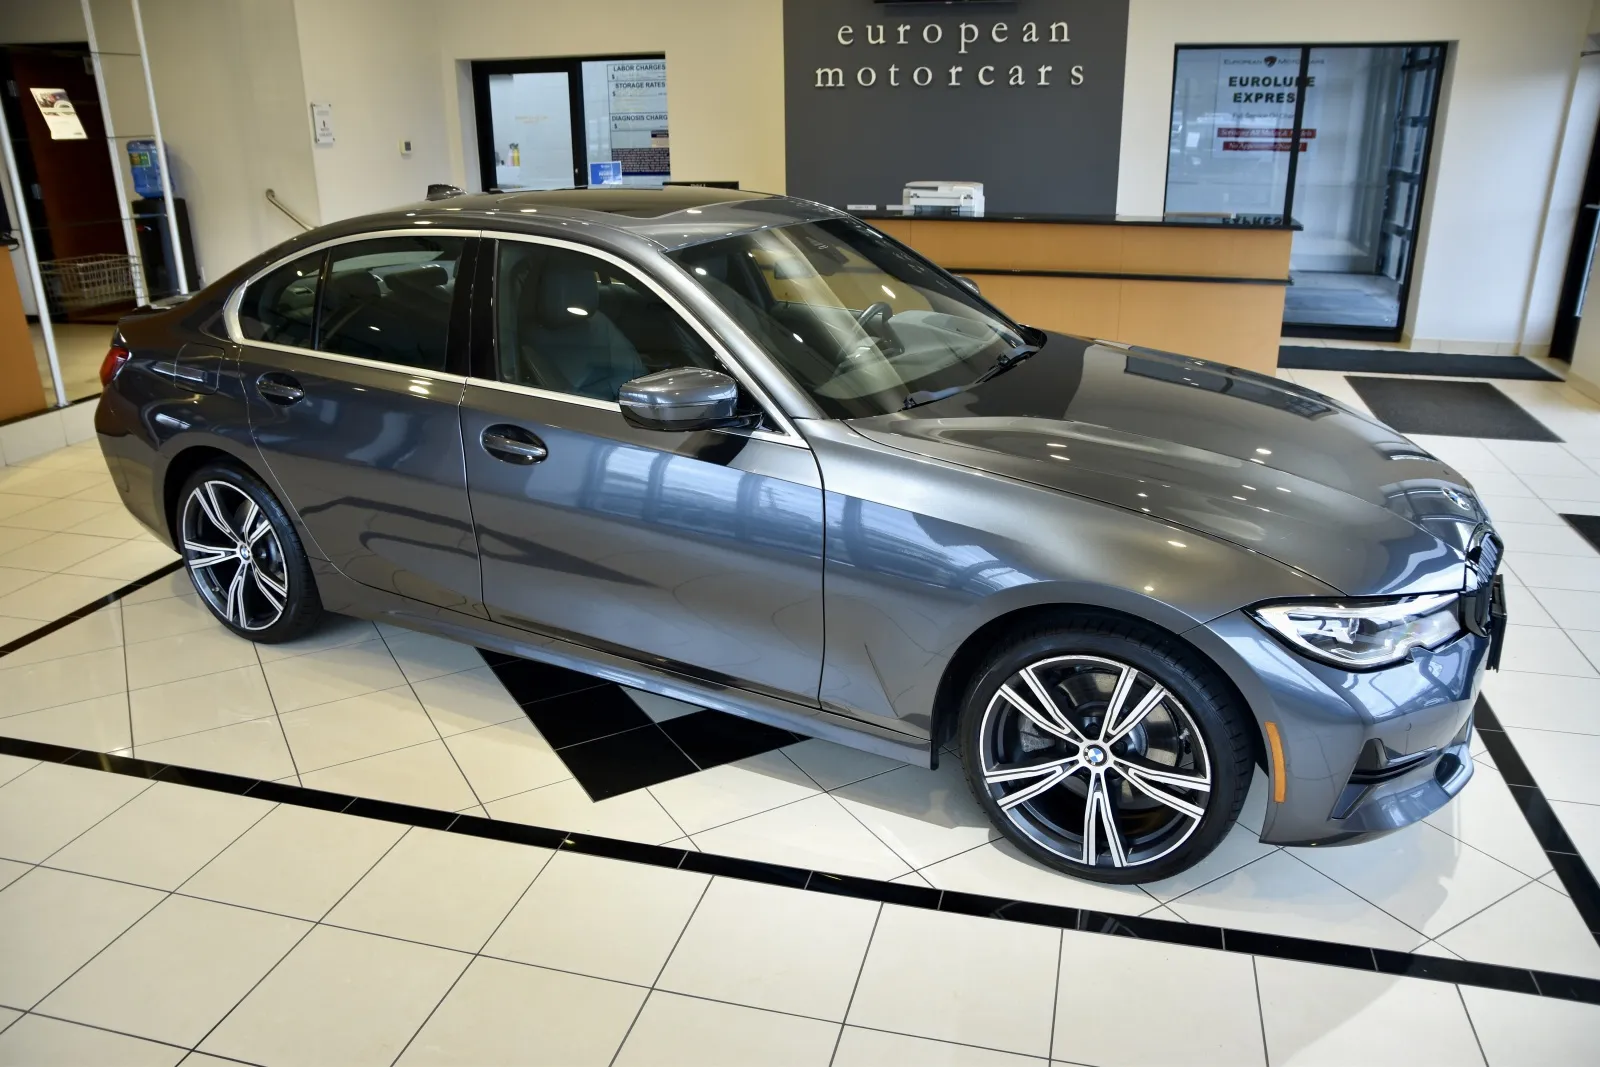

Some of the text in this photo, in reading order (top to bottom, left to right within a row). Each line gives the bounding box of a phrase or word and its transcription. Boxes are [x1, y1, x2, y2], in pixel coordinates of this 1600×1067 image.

[837, 20, 1071, 54] european
[814, 63, 1084, 87] motorcars
[1232, 92, 1296, 103] EXPRES
